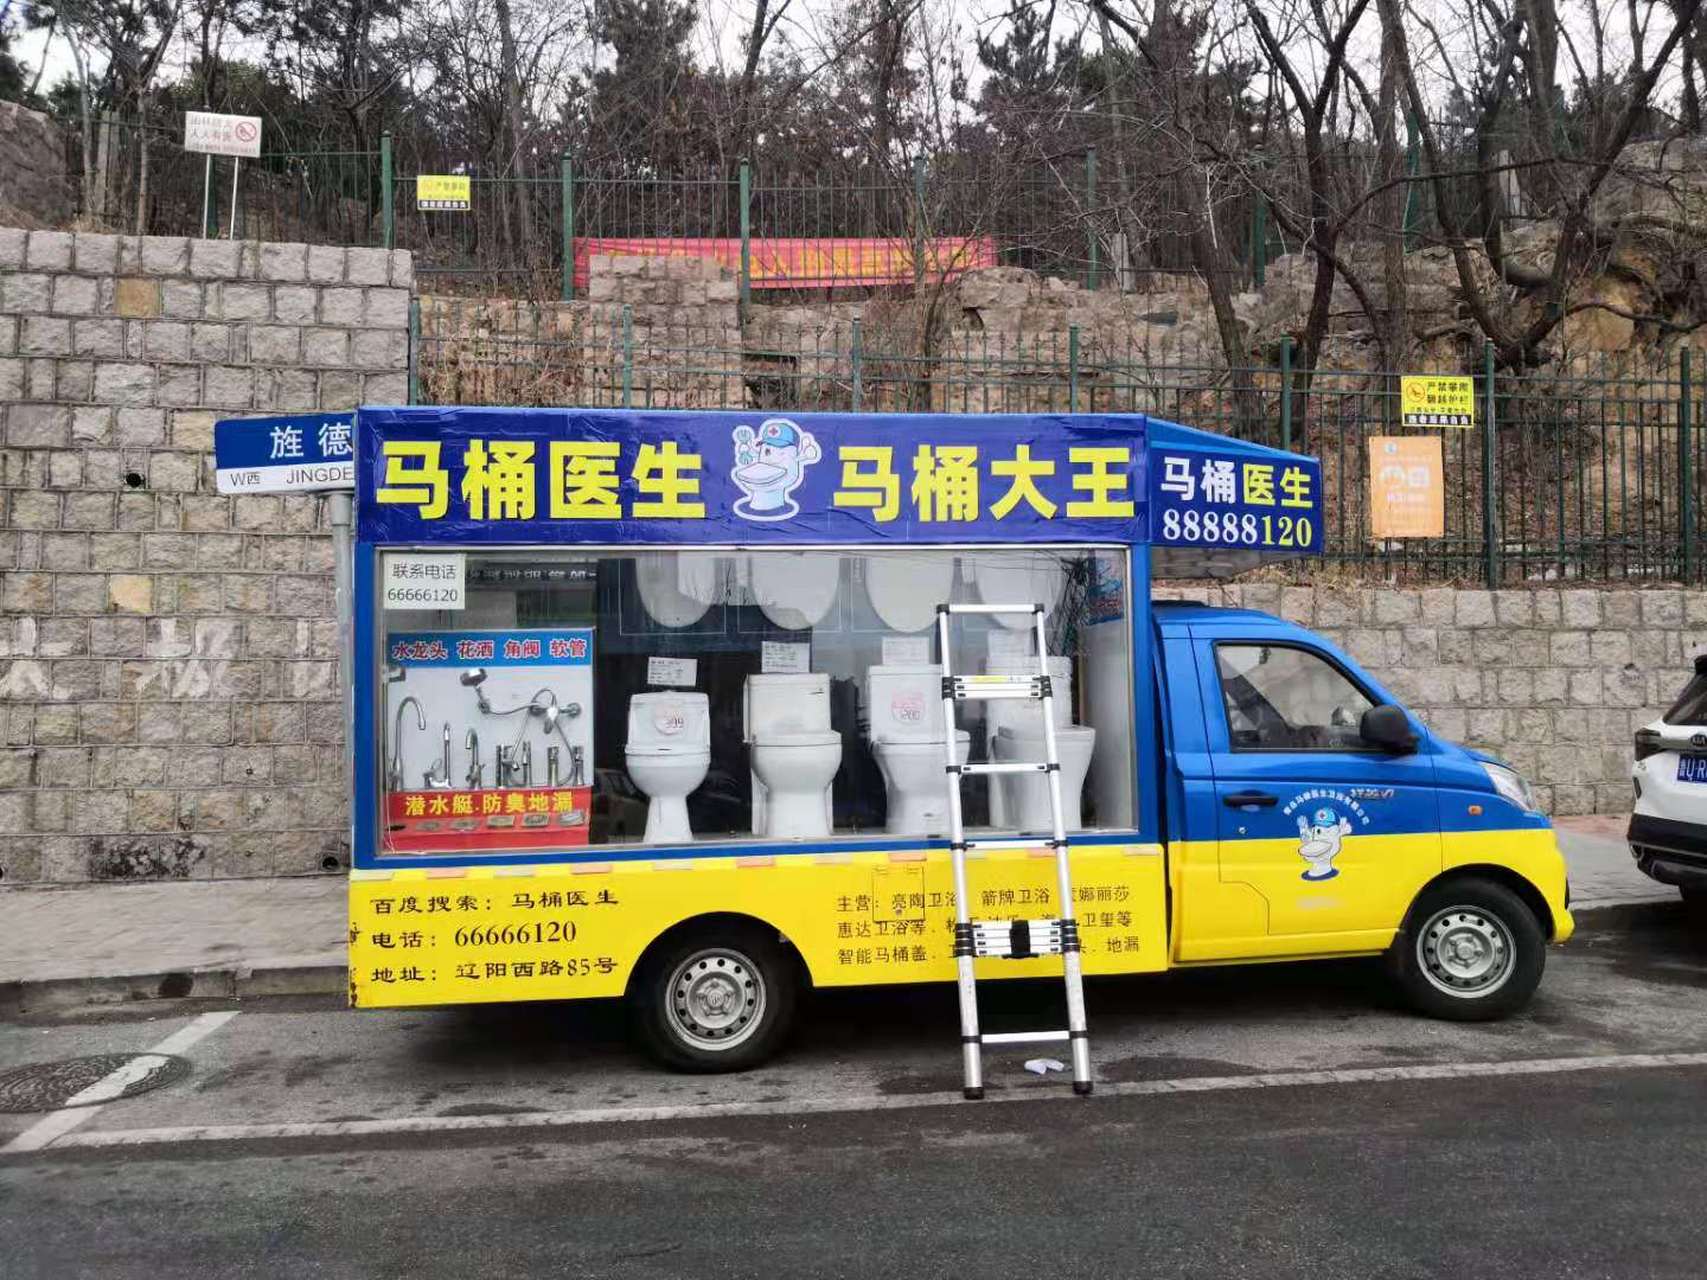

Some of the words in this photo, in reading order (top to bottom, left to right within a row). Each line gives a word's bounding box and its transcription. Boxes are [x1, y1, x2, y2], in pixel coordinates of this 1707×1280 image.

[286, 466, 354, 485] JINGDE
[376, 439, 706, 520] 马桶医生
[833, 444, 1134, 522] 马桶大王
[1160, 456, 1314, 509] 马桶医生
[1163, 508, 1313, 548] 88888120
[392, 563, 457, 580] 联系电话
[388, 588, 459, 602] 66666120
[391, 640, 449, 660] 水龙头
[455, 640, 495, 659] 花洒
[504, 639, 541, 658] 角阀
[549, 638, 587, 658] 软管
[511, 889, 619, 910] 马桶医生
[455, 920, 577, 947] 66666120
[455, 957, 618, 980] 辽阳西路85号
